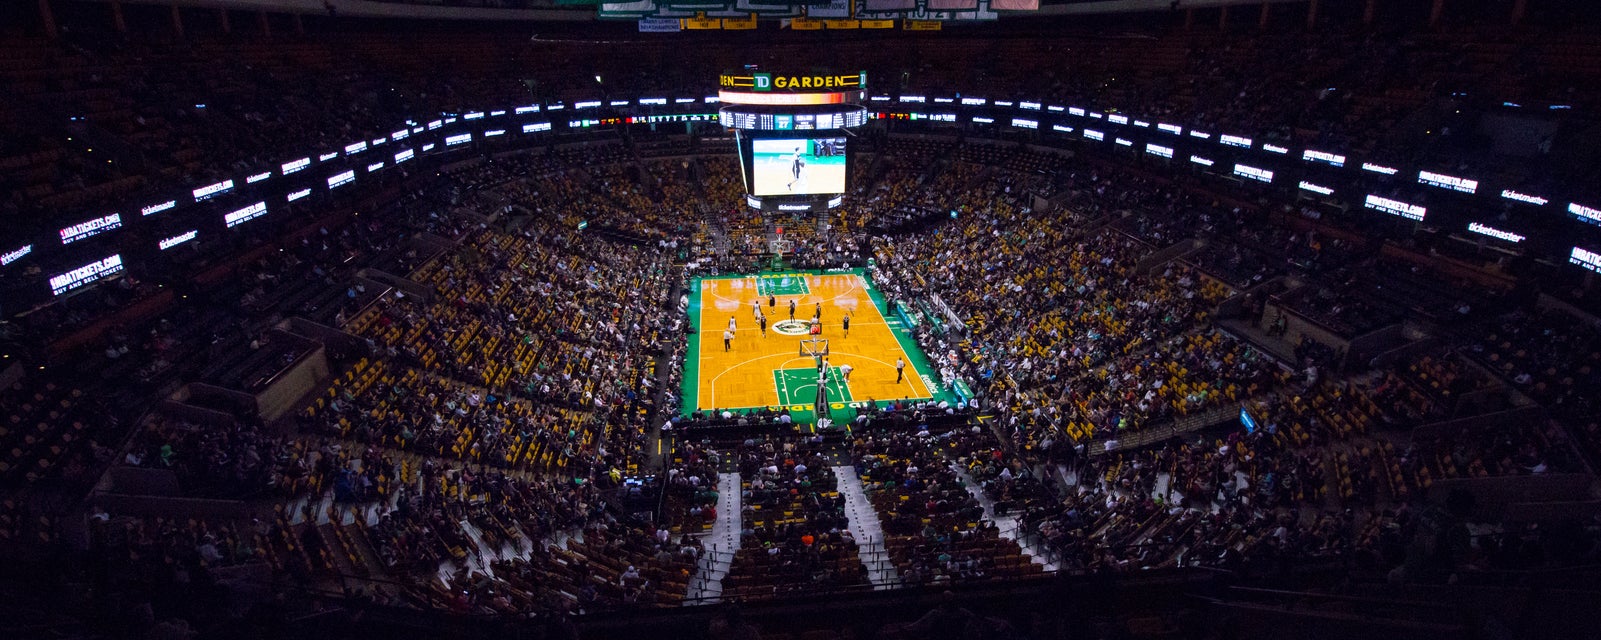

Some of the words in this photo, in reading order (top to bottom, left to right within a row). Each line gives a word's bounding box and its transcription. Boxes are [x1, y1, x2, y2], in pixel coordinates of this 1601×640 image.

[755, 76, 769, 88] TD
[775, 75, 844, 88] GARDEN
[1501, 189, 1547, 206] ticketmaster
[1468, 222, 1525, 243] ticketmaster
[51, 254, 122, 289] NBATICKETS.COM
[53, 286, 67, 296] BUY
[68, 280, 83, 290] AND
[83, 275, 99, 284] SELL
[99, 264, 124, 277] TICKETS
